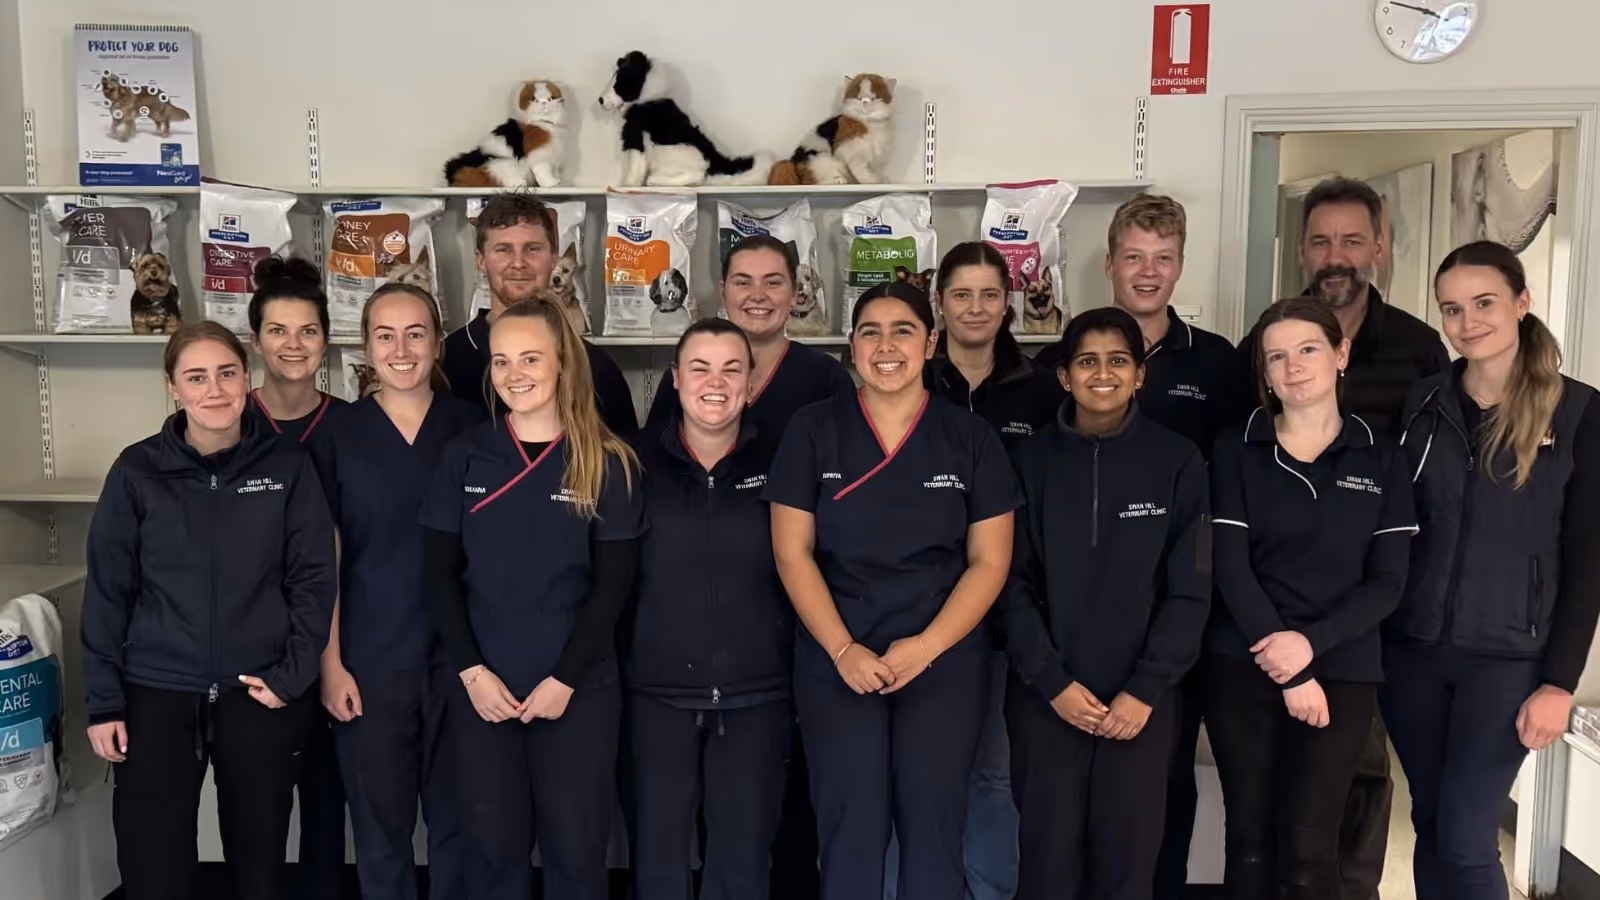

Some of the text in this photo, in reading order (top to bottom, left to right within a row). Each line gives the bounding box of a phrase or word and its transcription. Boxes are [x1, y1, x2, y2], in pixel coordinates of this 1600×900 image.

[88, 40, 179, 53] PROTECT YOUR DOG
[1400, 40, 1406, 49] 7
[1169, 67, 1189, 76] FIRE
[1152, 77, 1206, 87] EXTINGUISHER
[78, 225, 107, 237] CARE
[209, 249, 256, 259] DIGESTIVE
[614, 242, 656, 257] URINARY
[209, 258, 234, 267] CARE
[612, 251, 640, 265] CARE
[210, 278, 226, 290] i/d
[246, 478, 263, 487] SWAN
[933, 474, 960, 482] SWAN HILL
[1346, 475, 1375, 486] SWAN HILL
[236, 483, 285, 494] VETERINARY CLINIC
[923, 481, 954, 489] VETERINARY
[1336, 480, 1382, 495] VETERINARY CLINIC
[1128, 503, 1145, 511] SWAN
[1118, 507, 1168, 519] VETERINARY CLINIC
[0, 671, 43, 695] ENTAL
[0, 729, 20, 752] /d
